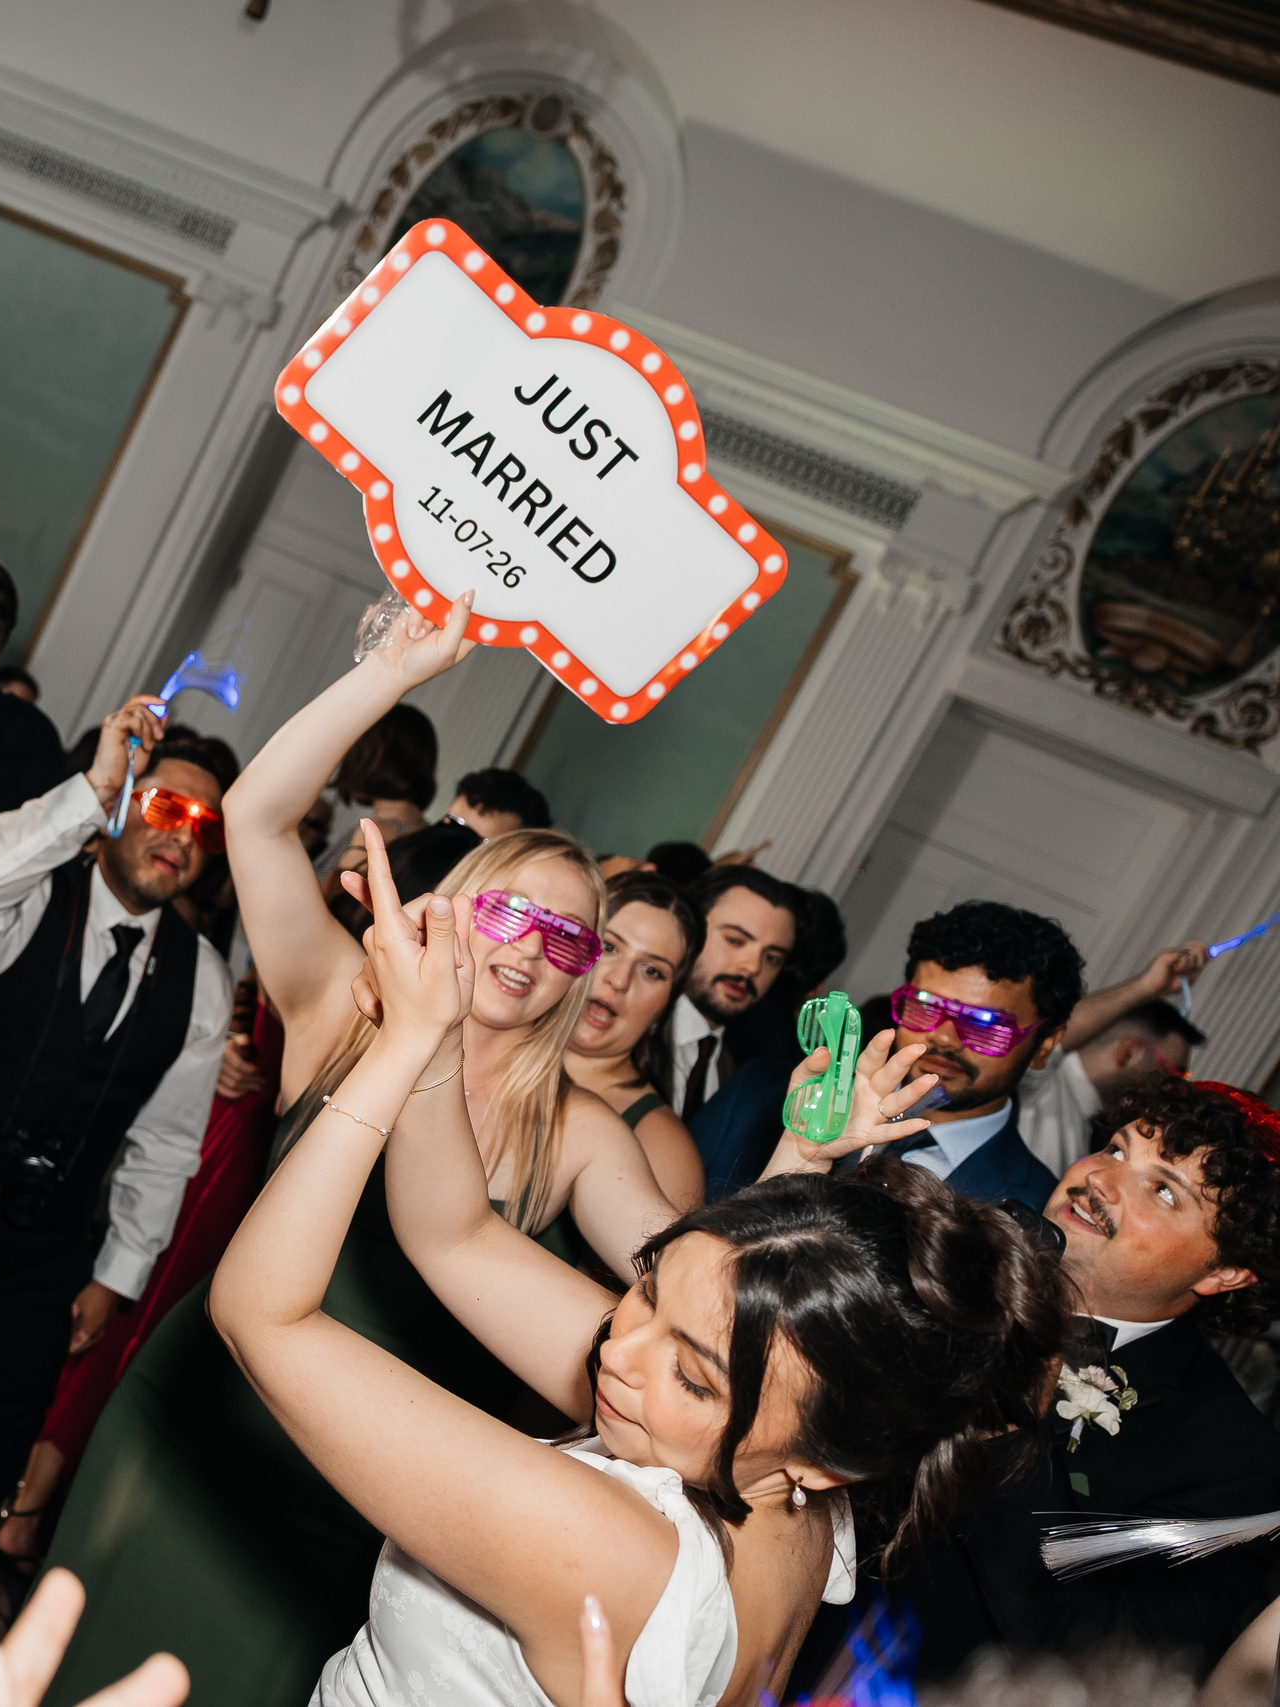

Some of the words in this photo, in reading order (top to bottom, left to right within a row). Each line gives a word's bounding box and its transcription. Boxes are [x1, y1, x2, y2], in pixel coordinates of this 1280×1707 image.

[514, 374, 640, 480] JUST
[416, 389, 617, 584] MARRIED
[417, 486, 527, 589] 11-07-26
